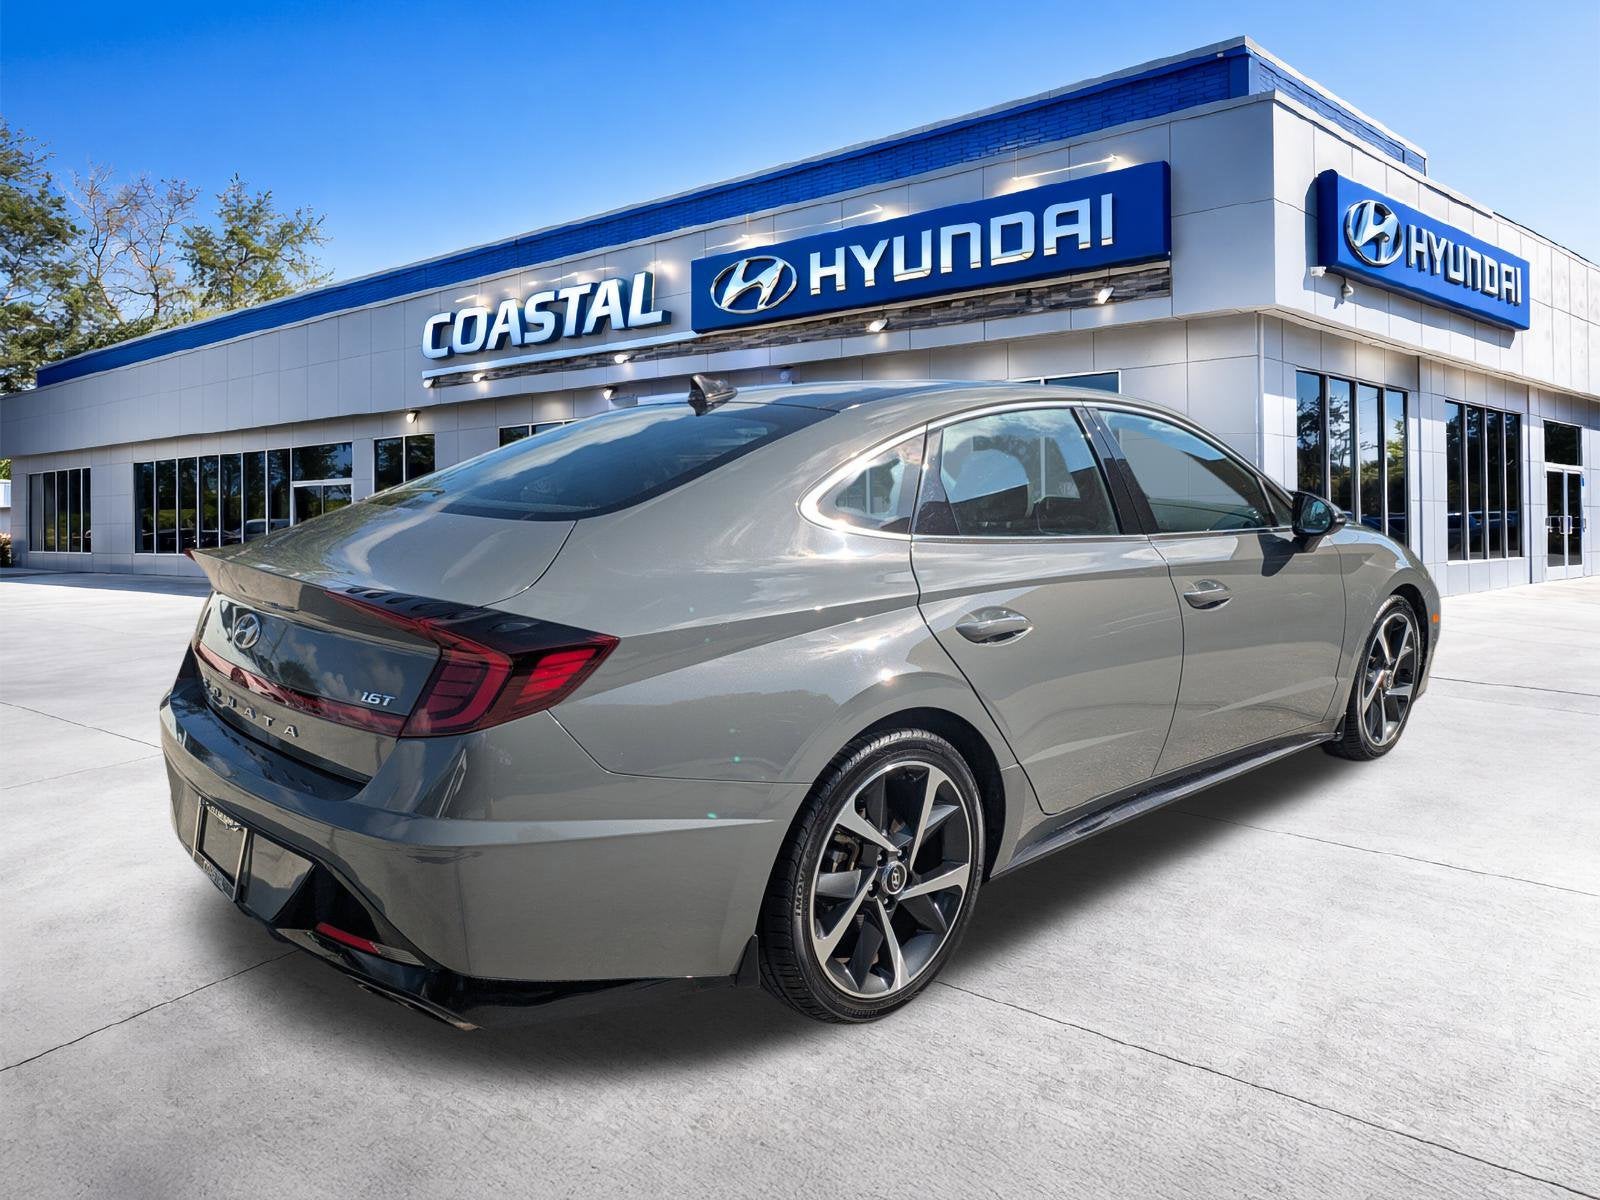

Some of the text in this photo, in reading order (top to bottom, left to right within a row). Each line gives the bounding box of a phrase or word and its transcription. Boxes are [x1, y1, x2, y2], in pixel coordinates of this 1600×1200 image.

[810, 193, 1114, 295] HYUNDAI
[1406, 224, 1522, 306] HYUNDAI
[422, 271, 669, 359] COASTAL
